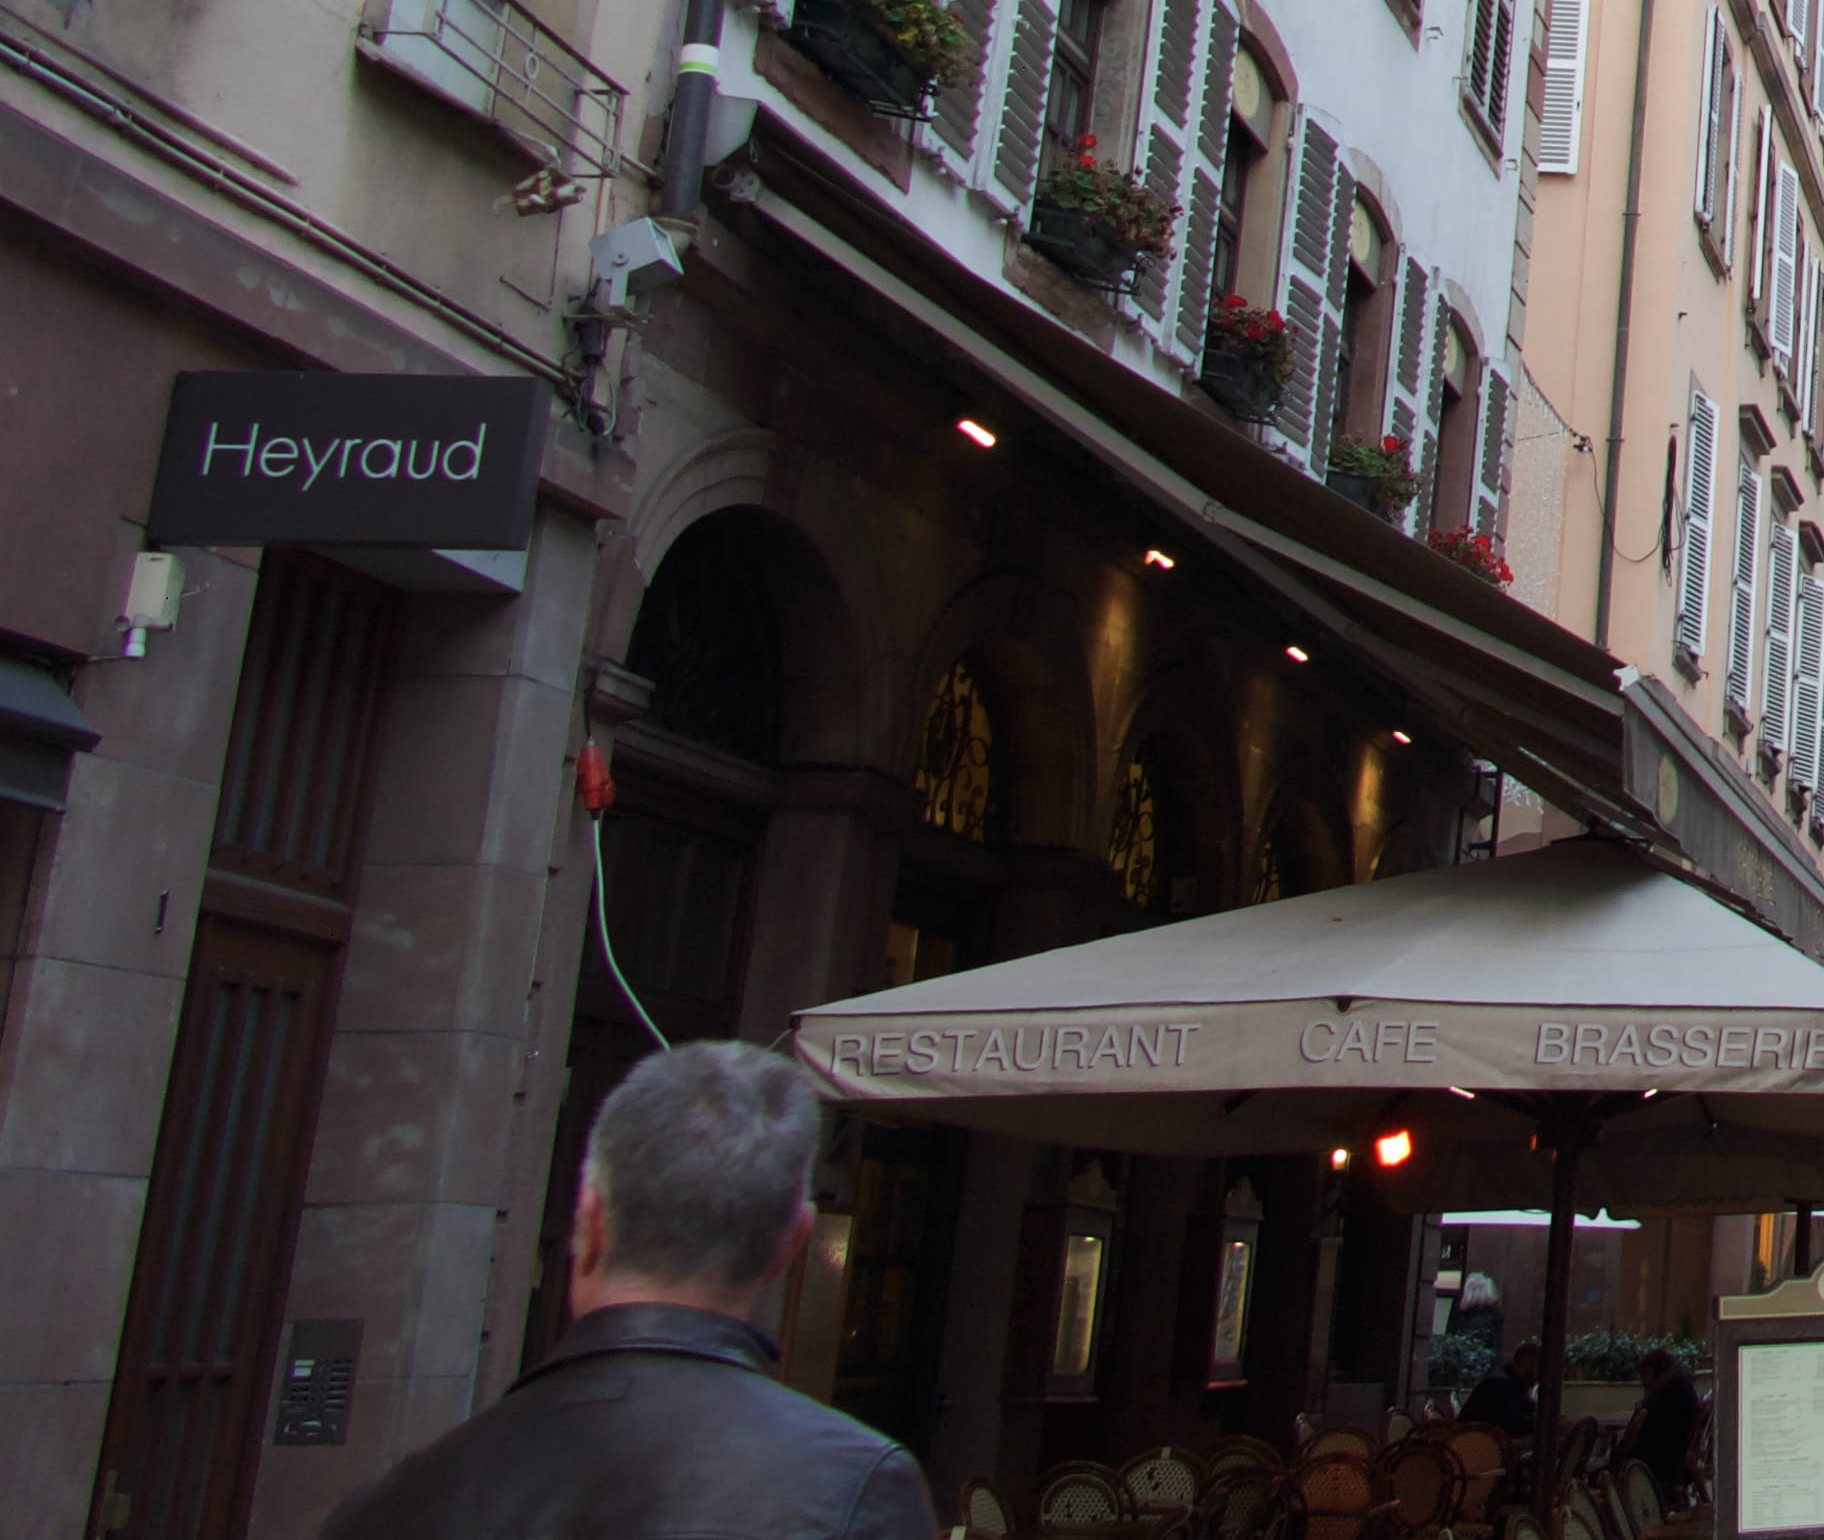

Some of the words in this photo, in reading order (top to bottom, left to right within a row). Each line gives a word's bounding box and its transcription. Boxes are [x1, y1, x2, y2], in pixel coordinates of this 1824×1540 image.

[201, 421, 488, 492] Heyraud
[830, 1021, 1203, 1078] RESTAURANT
[1299, 1019, 1440, 1064] CAFE
